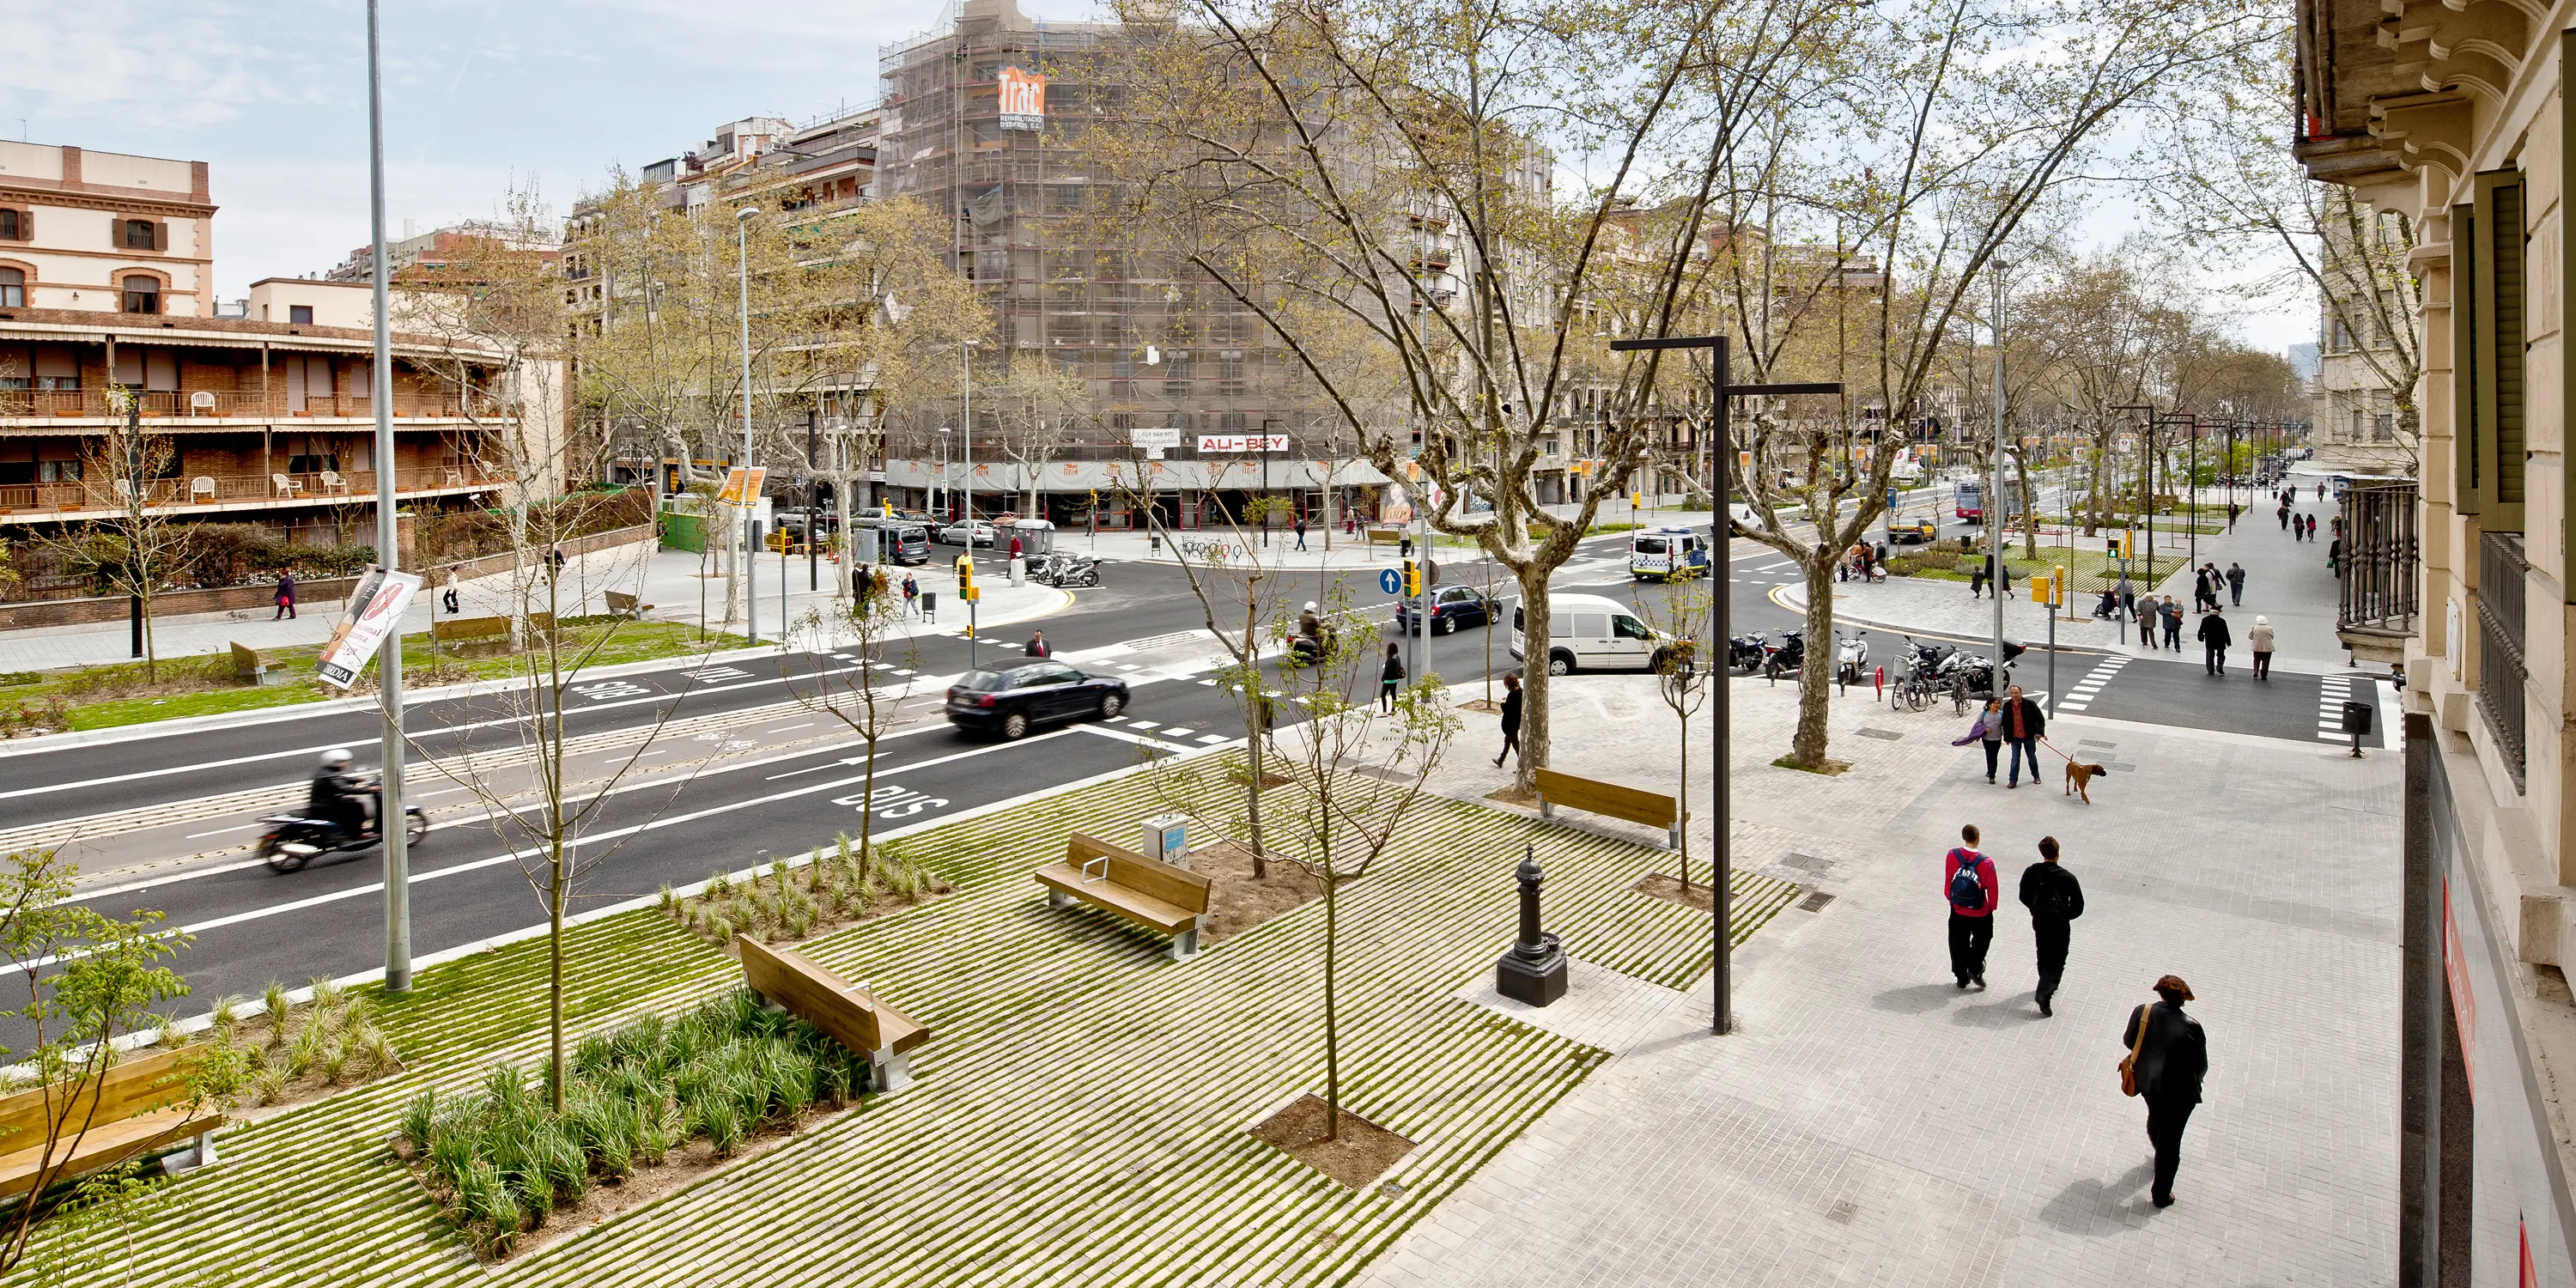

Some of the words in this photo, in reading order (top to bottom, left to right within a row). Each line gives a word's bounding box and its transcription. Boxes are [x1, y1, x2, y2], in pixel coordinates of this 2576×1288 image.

[999, 74, 1041, 113] Trac
[571, 681, 651, 700] BUS
[830, 785, 950, 818] BUS
